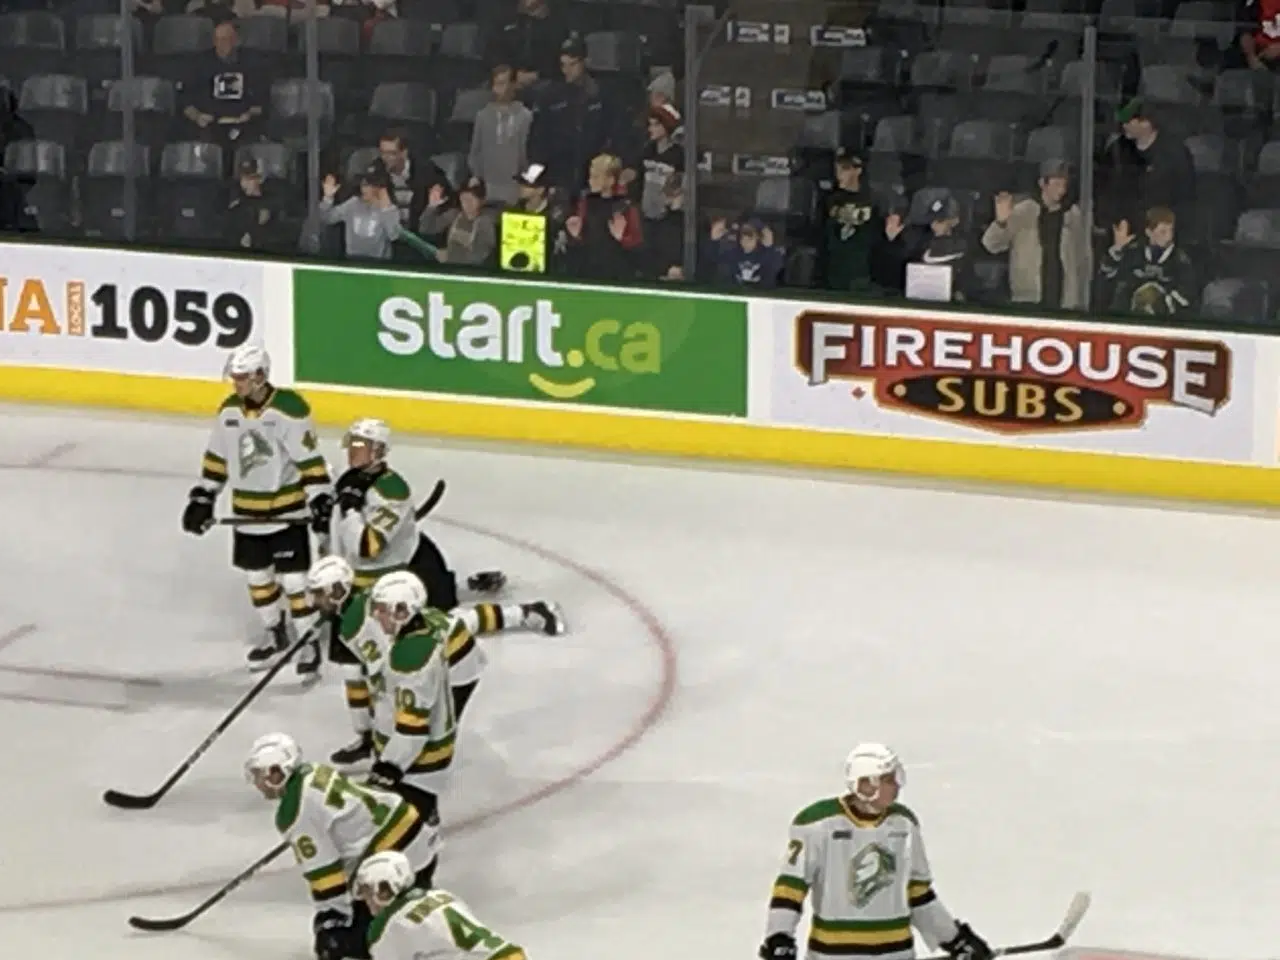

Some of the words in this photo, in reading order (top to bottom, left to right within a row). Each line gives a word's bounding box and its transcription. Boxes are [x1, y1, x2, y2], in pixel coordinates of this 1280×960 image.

[89, 283, 254, 348] 1059
[377, 291, 662, 375] start.ca
[807, 320, 1218, 416] FIREHOUSE
[934, 377, 1085, 423] SUBS
